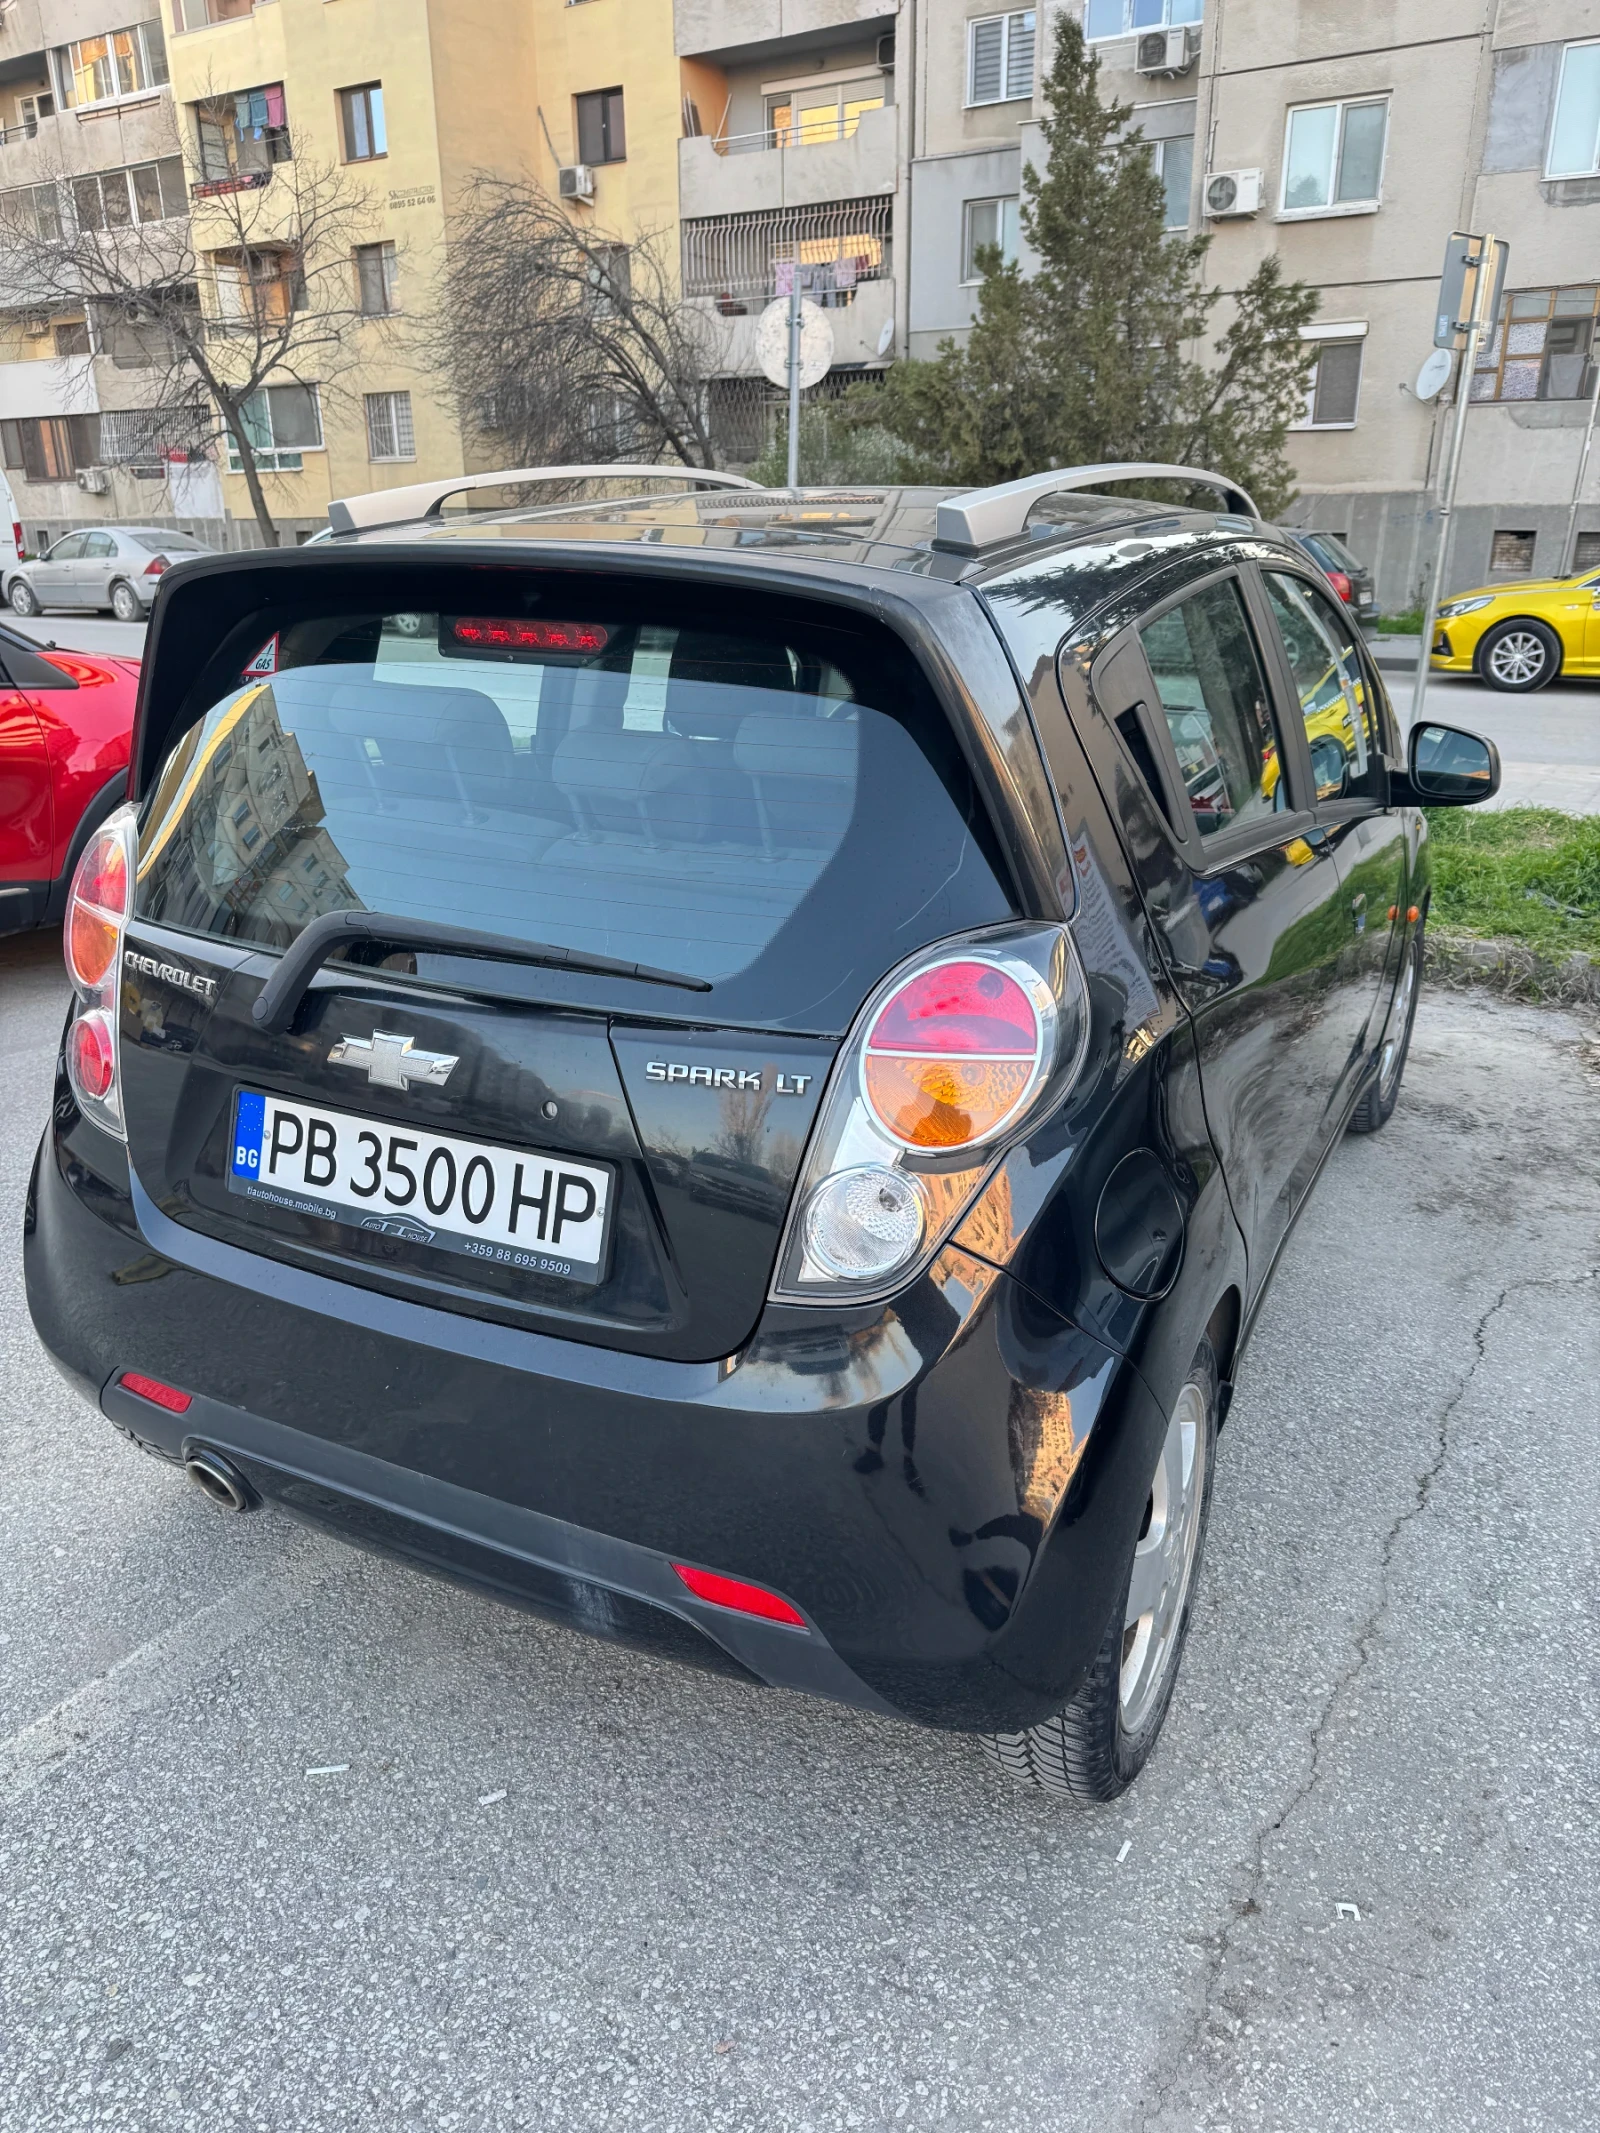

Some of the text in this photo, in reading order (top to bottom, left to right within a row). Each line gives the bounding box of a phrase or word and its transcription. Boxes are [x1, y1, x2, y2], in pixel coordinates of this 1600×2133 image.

[255, 658, 272, 670] GAS
[124, 950, 216, 996] CHEVROLET
[645, 1061, 812, 1095] SPARK LT
[235, 1145, 259, 1168] BG
[268, 1109, 597, 1244] PB 3500 HP
[246, 1185, 337, 1220] tiautohouse.mobile.bg
[364, 1221, 381, 1231] AUTO
[407, 1232, 428, 1243] HOUSE
[464, 1242, 571, 1275] +359 88 695 9509
